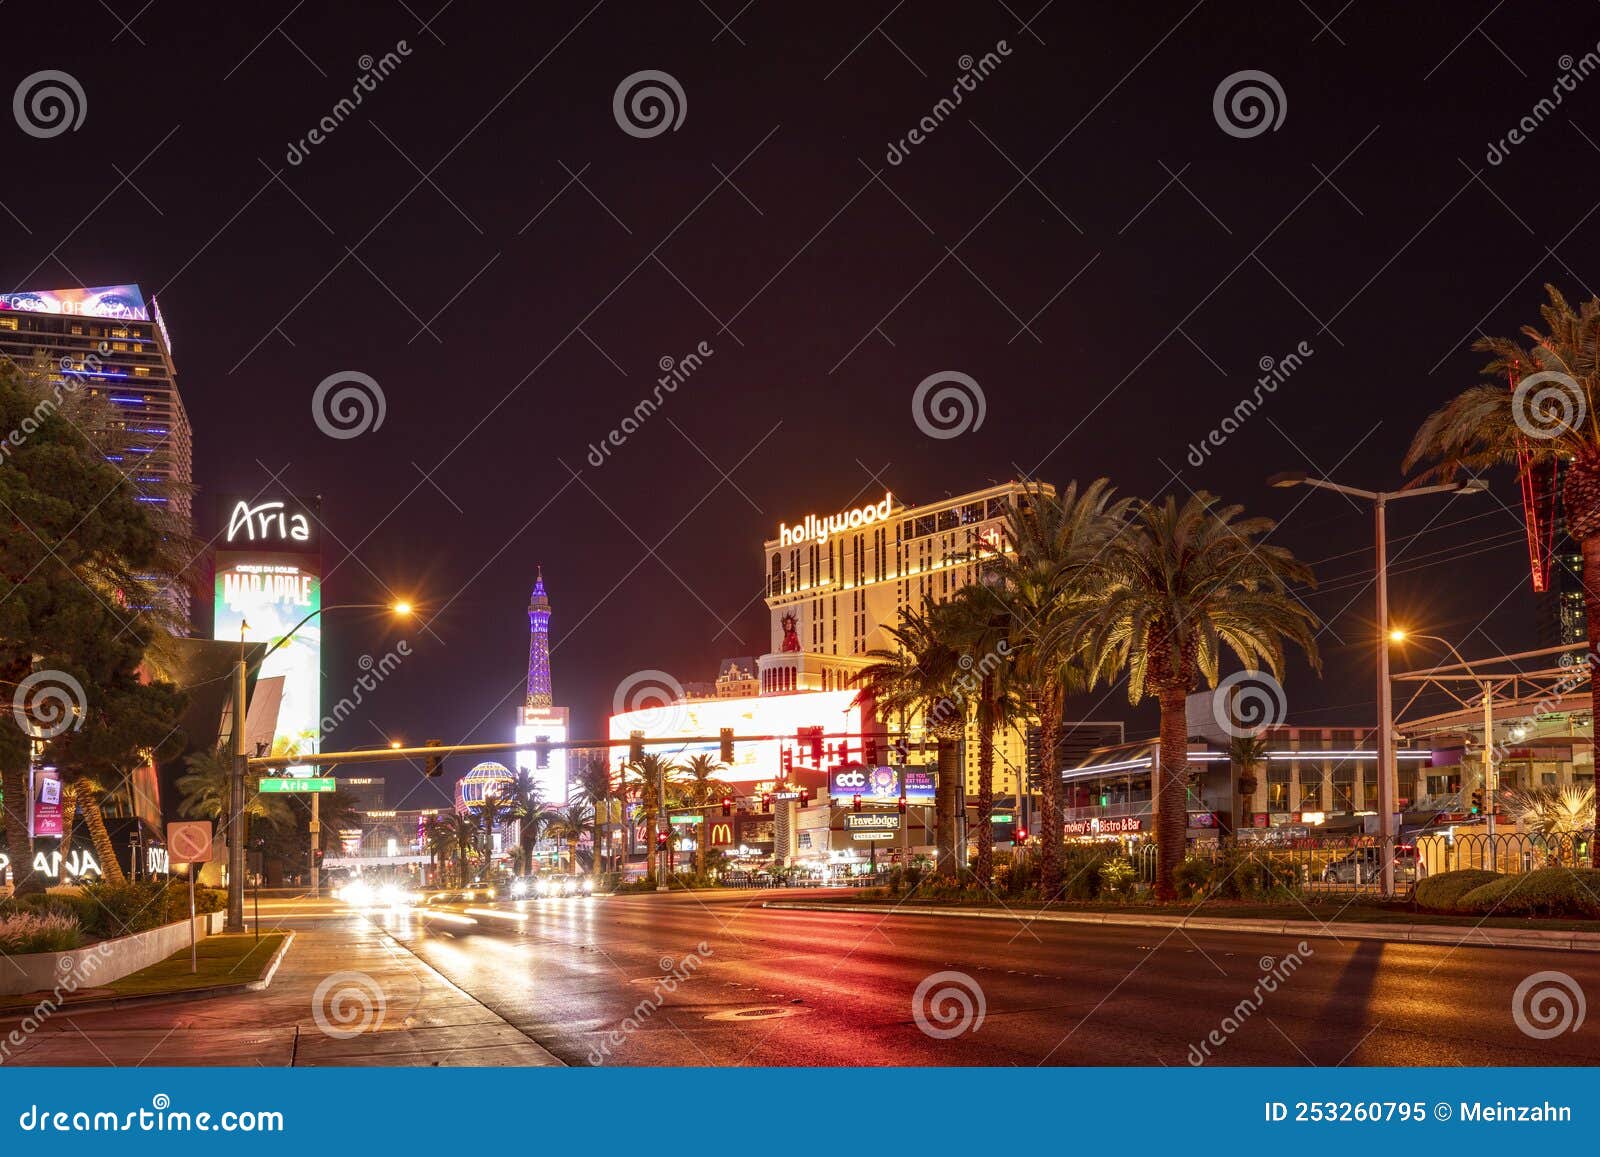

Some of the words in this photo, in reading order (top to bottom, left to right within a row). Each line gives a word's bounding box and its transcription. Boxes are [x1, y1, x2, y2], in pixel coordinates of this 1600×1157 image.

[12, 297, 146, 320] CSOPTAN
[227, 501, 309, 542] Aria
[779, 491, 893, 548] hollywood
[279, 780, 309, 791] Aria
[836, 769, 865, 787] edc
[848, 815, 898, 828] Travelodge
[1064, 821, 1091, 835] mokey's
[1100, 820, 1121, 832] Bistro
[1121, 818, 1128, 831] &
[1127, 818, 1140, 831] Bar
